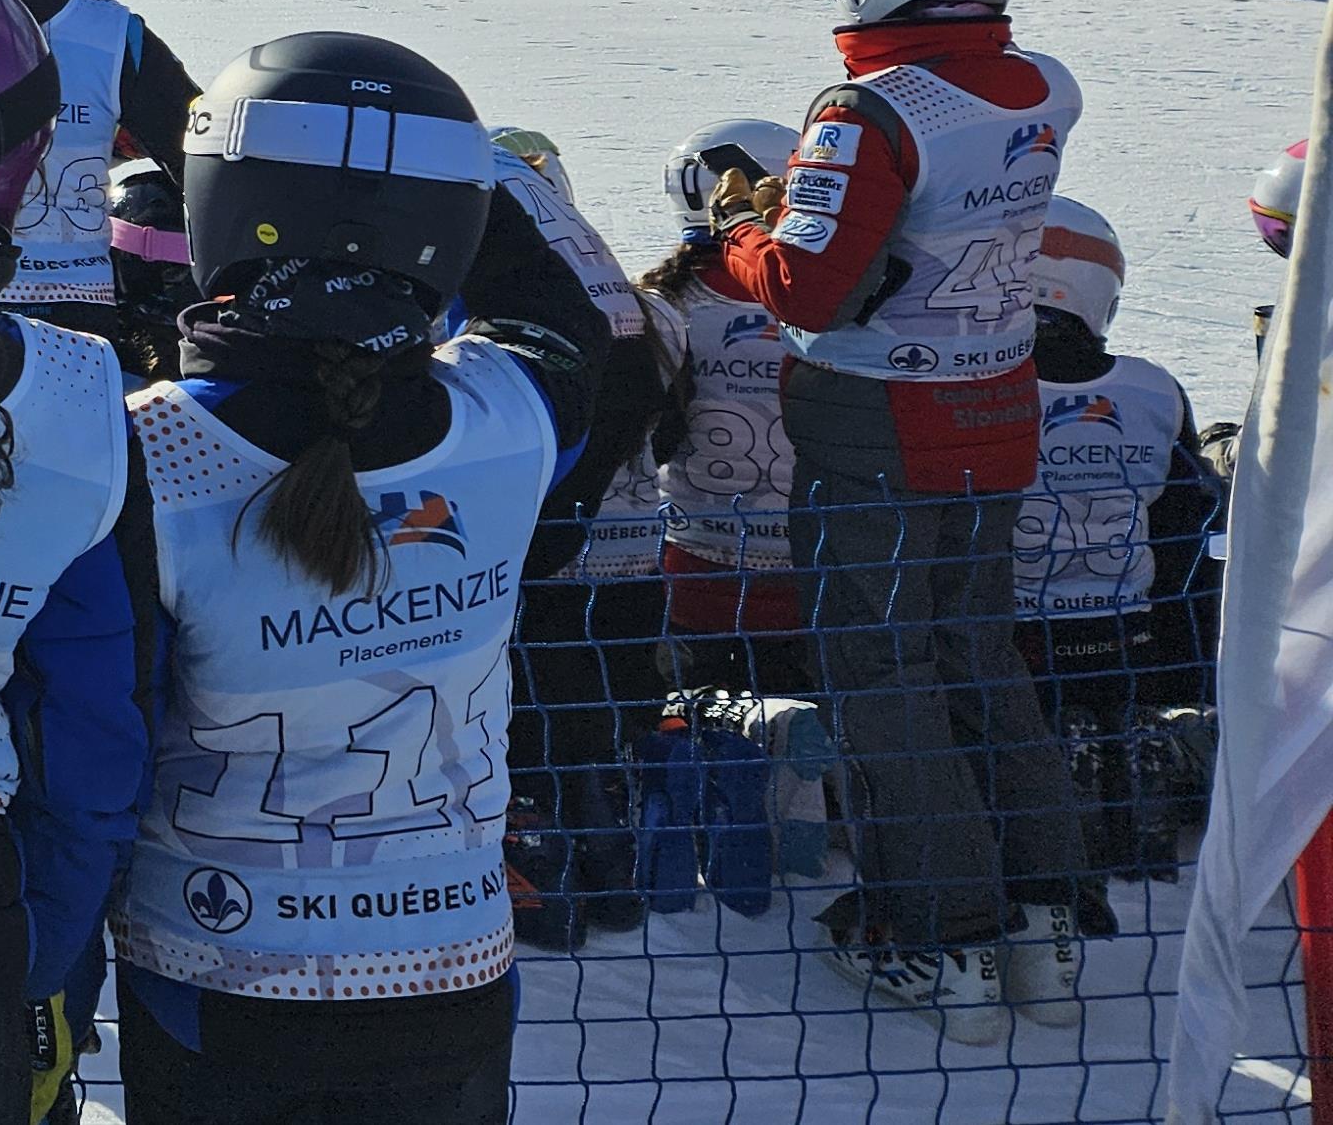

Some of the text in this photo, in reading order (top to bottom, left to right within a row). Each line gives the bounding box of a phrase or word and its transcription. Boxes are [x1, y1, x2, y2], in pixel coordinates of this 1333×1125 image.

[351, 79, 393, 94] POC
[964, 173, 1055, 210] MACKEN
[693, 359, 781, 379] MACKE
[953, 352, 989, 367] SKI
[725, 382, 779, 396] Placem
[1035, 446, 1155, 466] ACKENZIE
[260, 559, 510, 651] MACKENZIE
[339, 627, 462, 666] Placements
[277, 895, 337, 921] SKI
[350, 879, 476, 920] QUÉBEC
